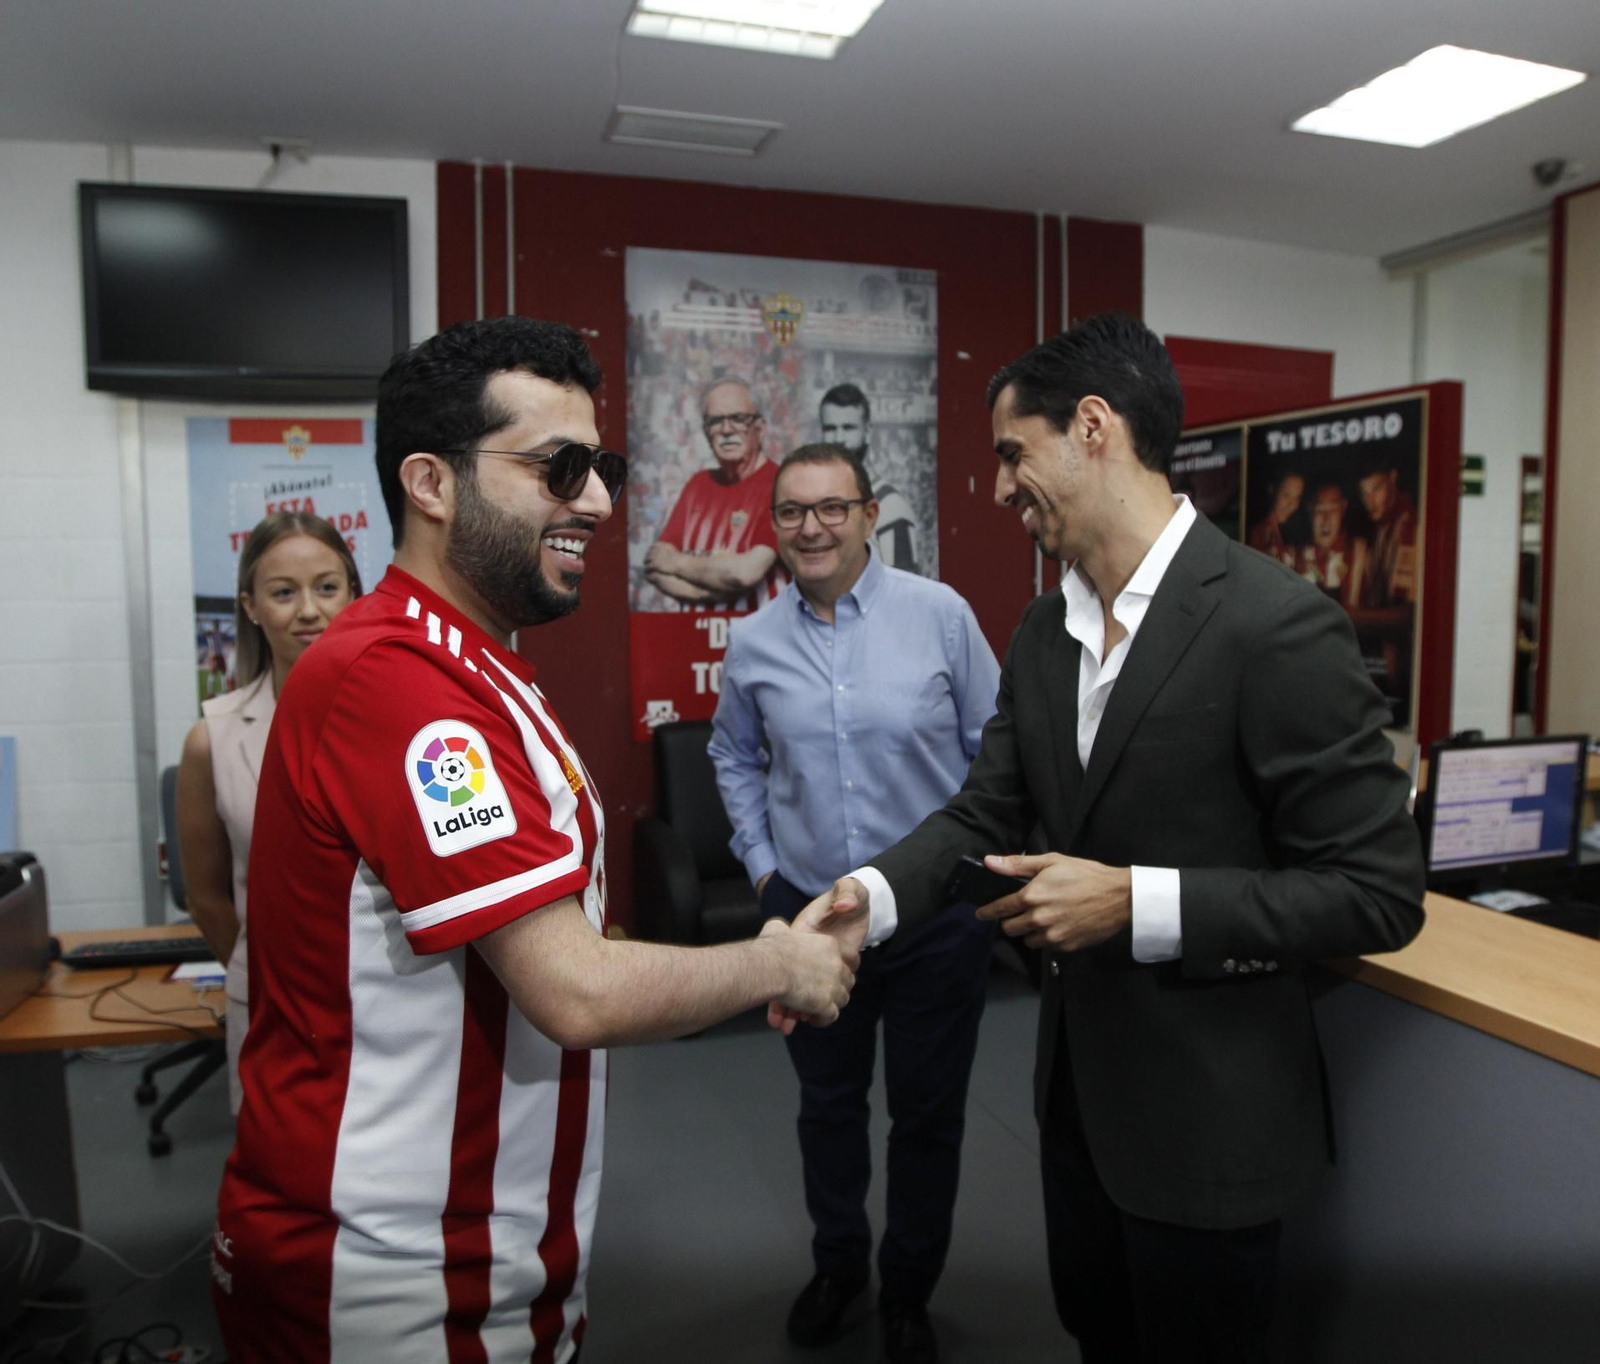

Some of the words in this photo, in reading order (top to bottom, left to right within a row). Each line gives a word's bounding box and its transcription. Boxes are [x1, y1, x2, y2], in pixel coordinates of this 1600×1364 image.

[1267, 430, 1296, 454] Tu
[1300, 413, 1403, 448] TESORO
[433, 804, 504, 838] LaLiga
